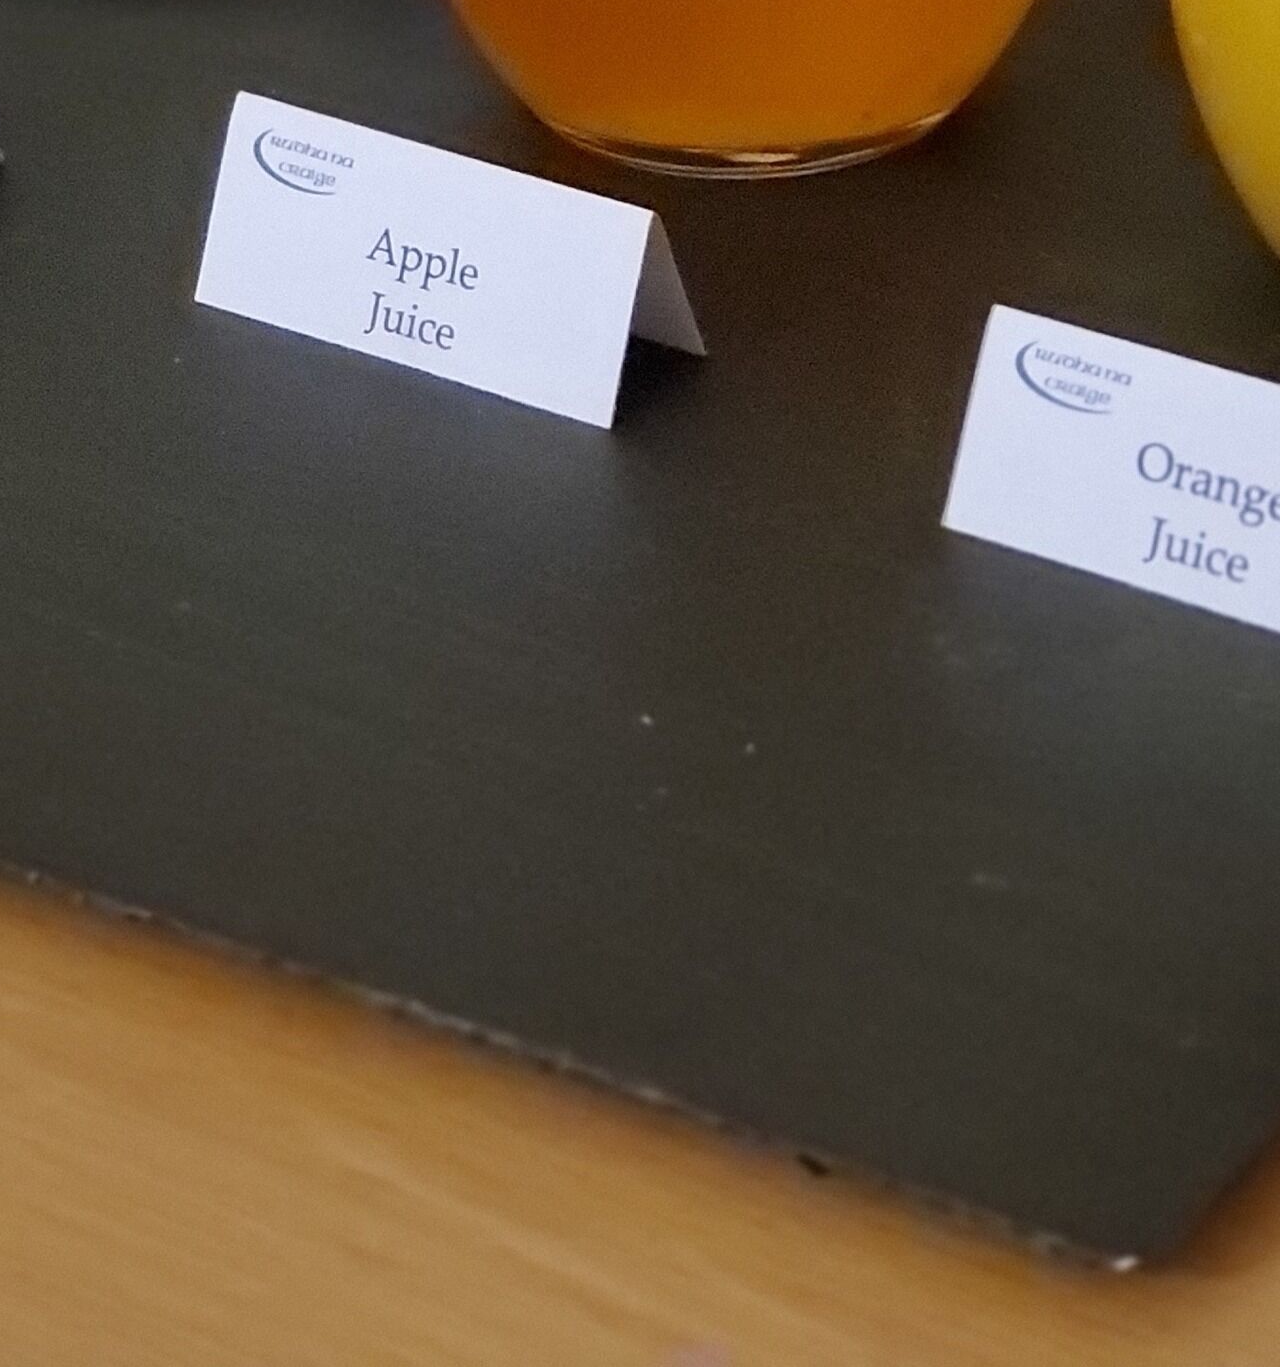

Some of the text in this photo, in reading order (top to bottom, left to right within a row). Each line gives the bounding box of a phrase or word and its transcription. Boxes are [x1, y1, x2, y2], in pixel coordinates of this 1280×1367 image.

[365, 227, 479, 292] Apple
[363, 290, 455, 351] Juice
[1141, 515, 1250, 584] Juice
